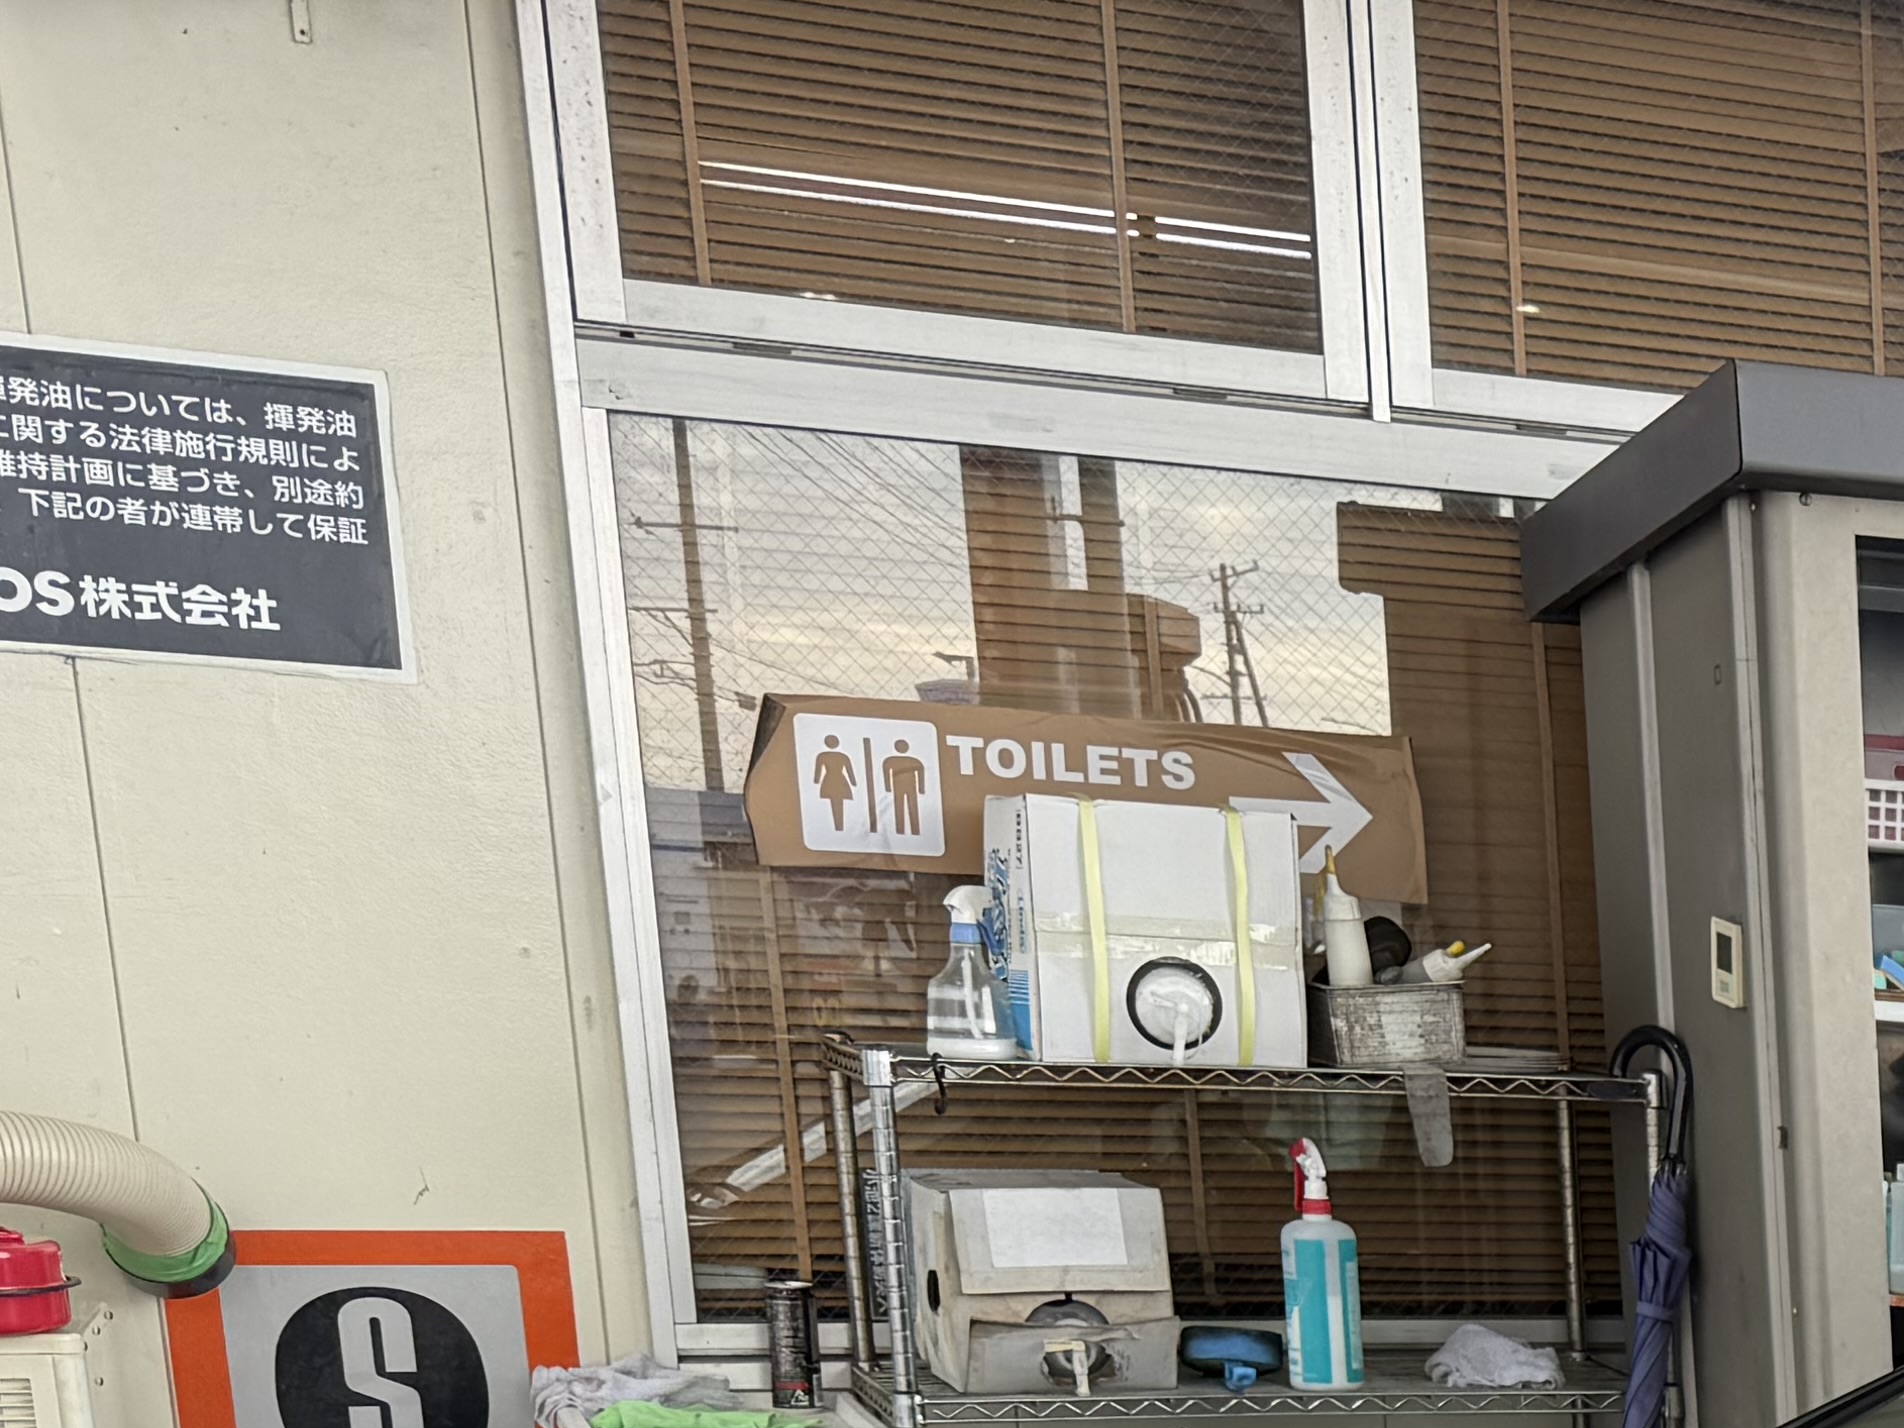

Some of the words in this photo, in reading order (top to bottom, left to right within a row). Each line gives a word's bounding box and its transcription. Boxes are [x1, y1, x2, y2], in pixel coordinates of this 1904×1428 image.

[0, 376, 357, 438] 発油については、揮発油
[18, 487, 369, 545] 下記の者が連帯して保証
[945, 734, 1197, 791] TOILETS
